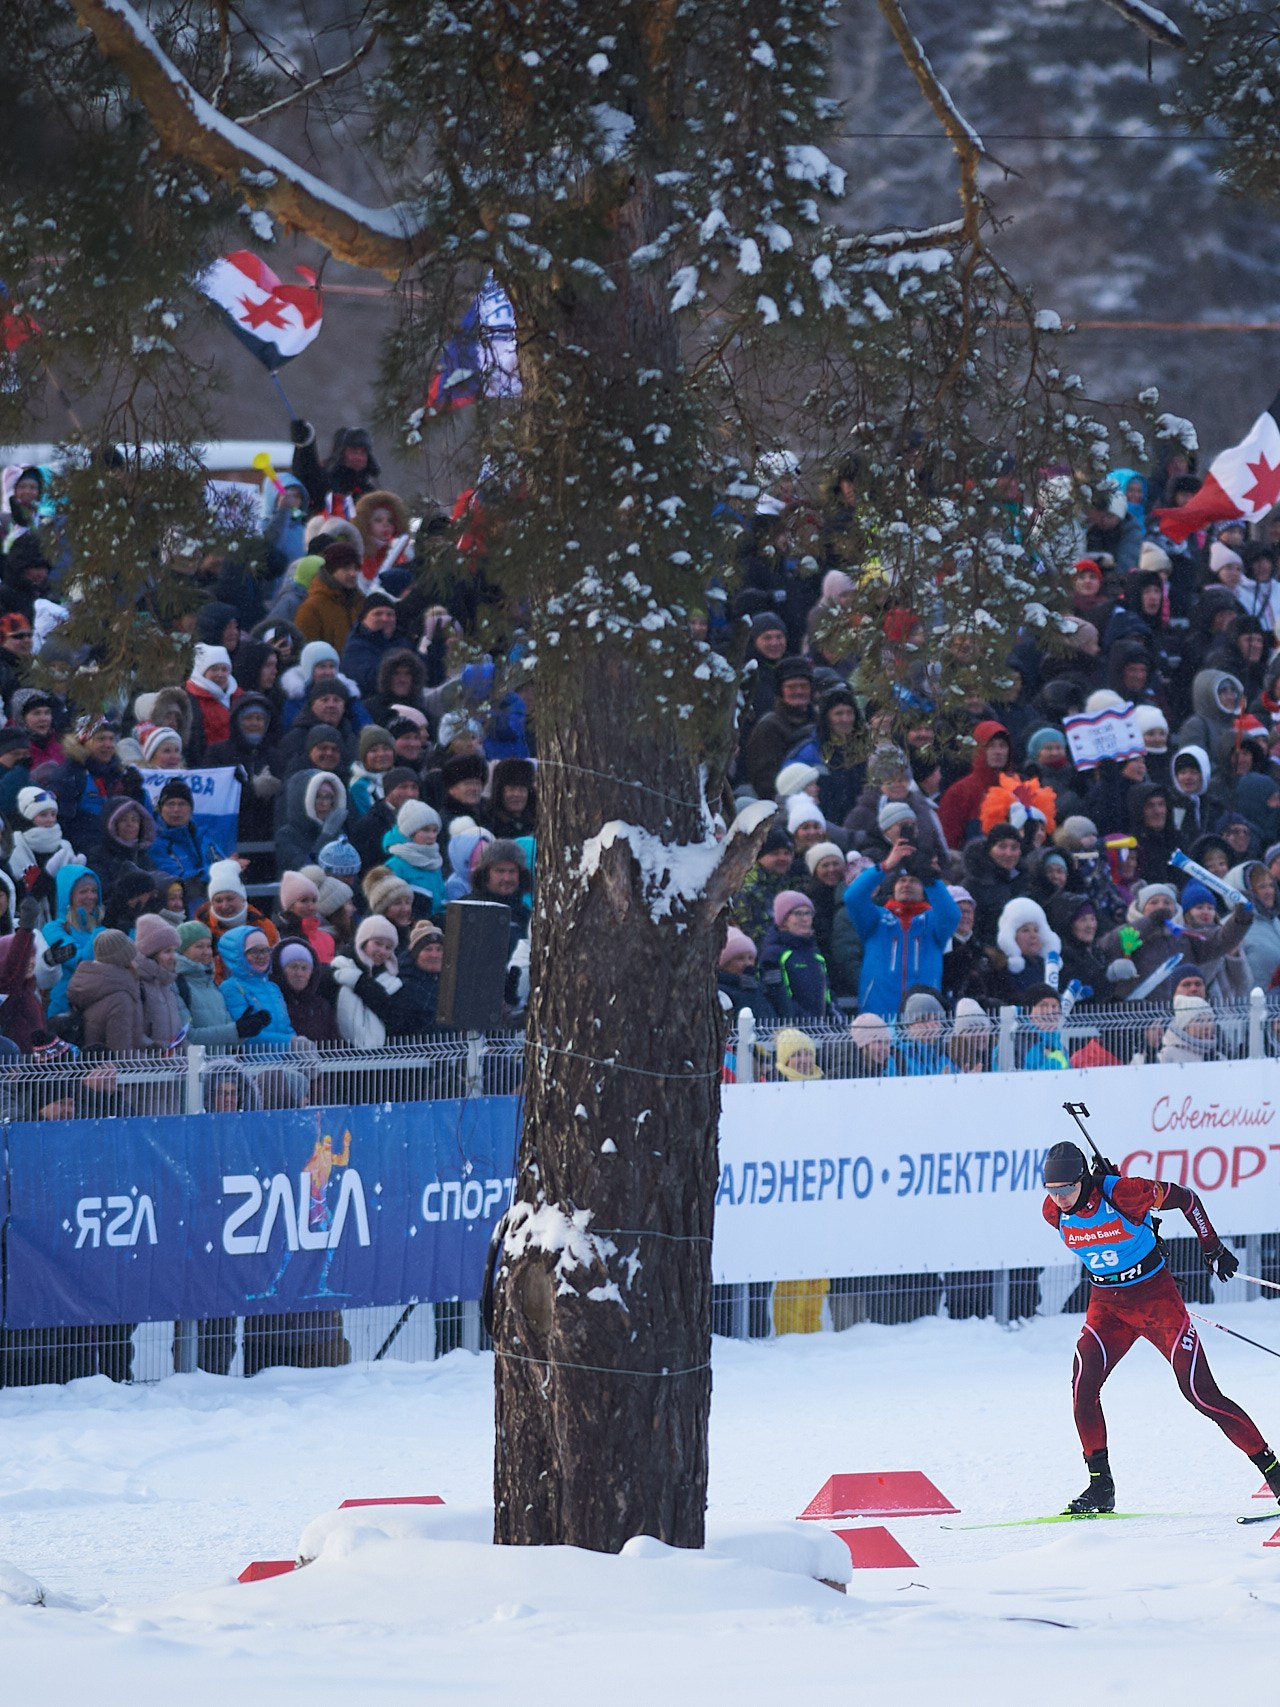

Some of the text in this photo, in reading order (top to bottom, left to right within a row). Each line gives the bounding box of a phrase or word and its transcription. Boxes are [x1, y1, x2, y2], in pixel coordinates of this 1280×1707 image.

[1152, 1095, 1276, 1132] Советский
[715, 1149, 1050, 1206] АЛЭНЕРГО ЭЛЕКТРИК
[422, 1178, 517, 1222] СПОРТ
[1068, 1228, 1122, 1244] Альфа Банк
[1086, 1249, 1119, 1269] 29
